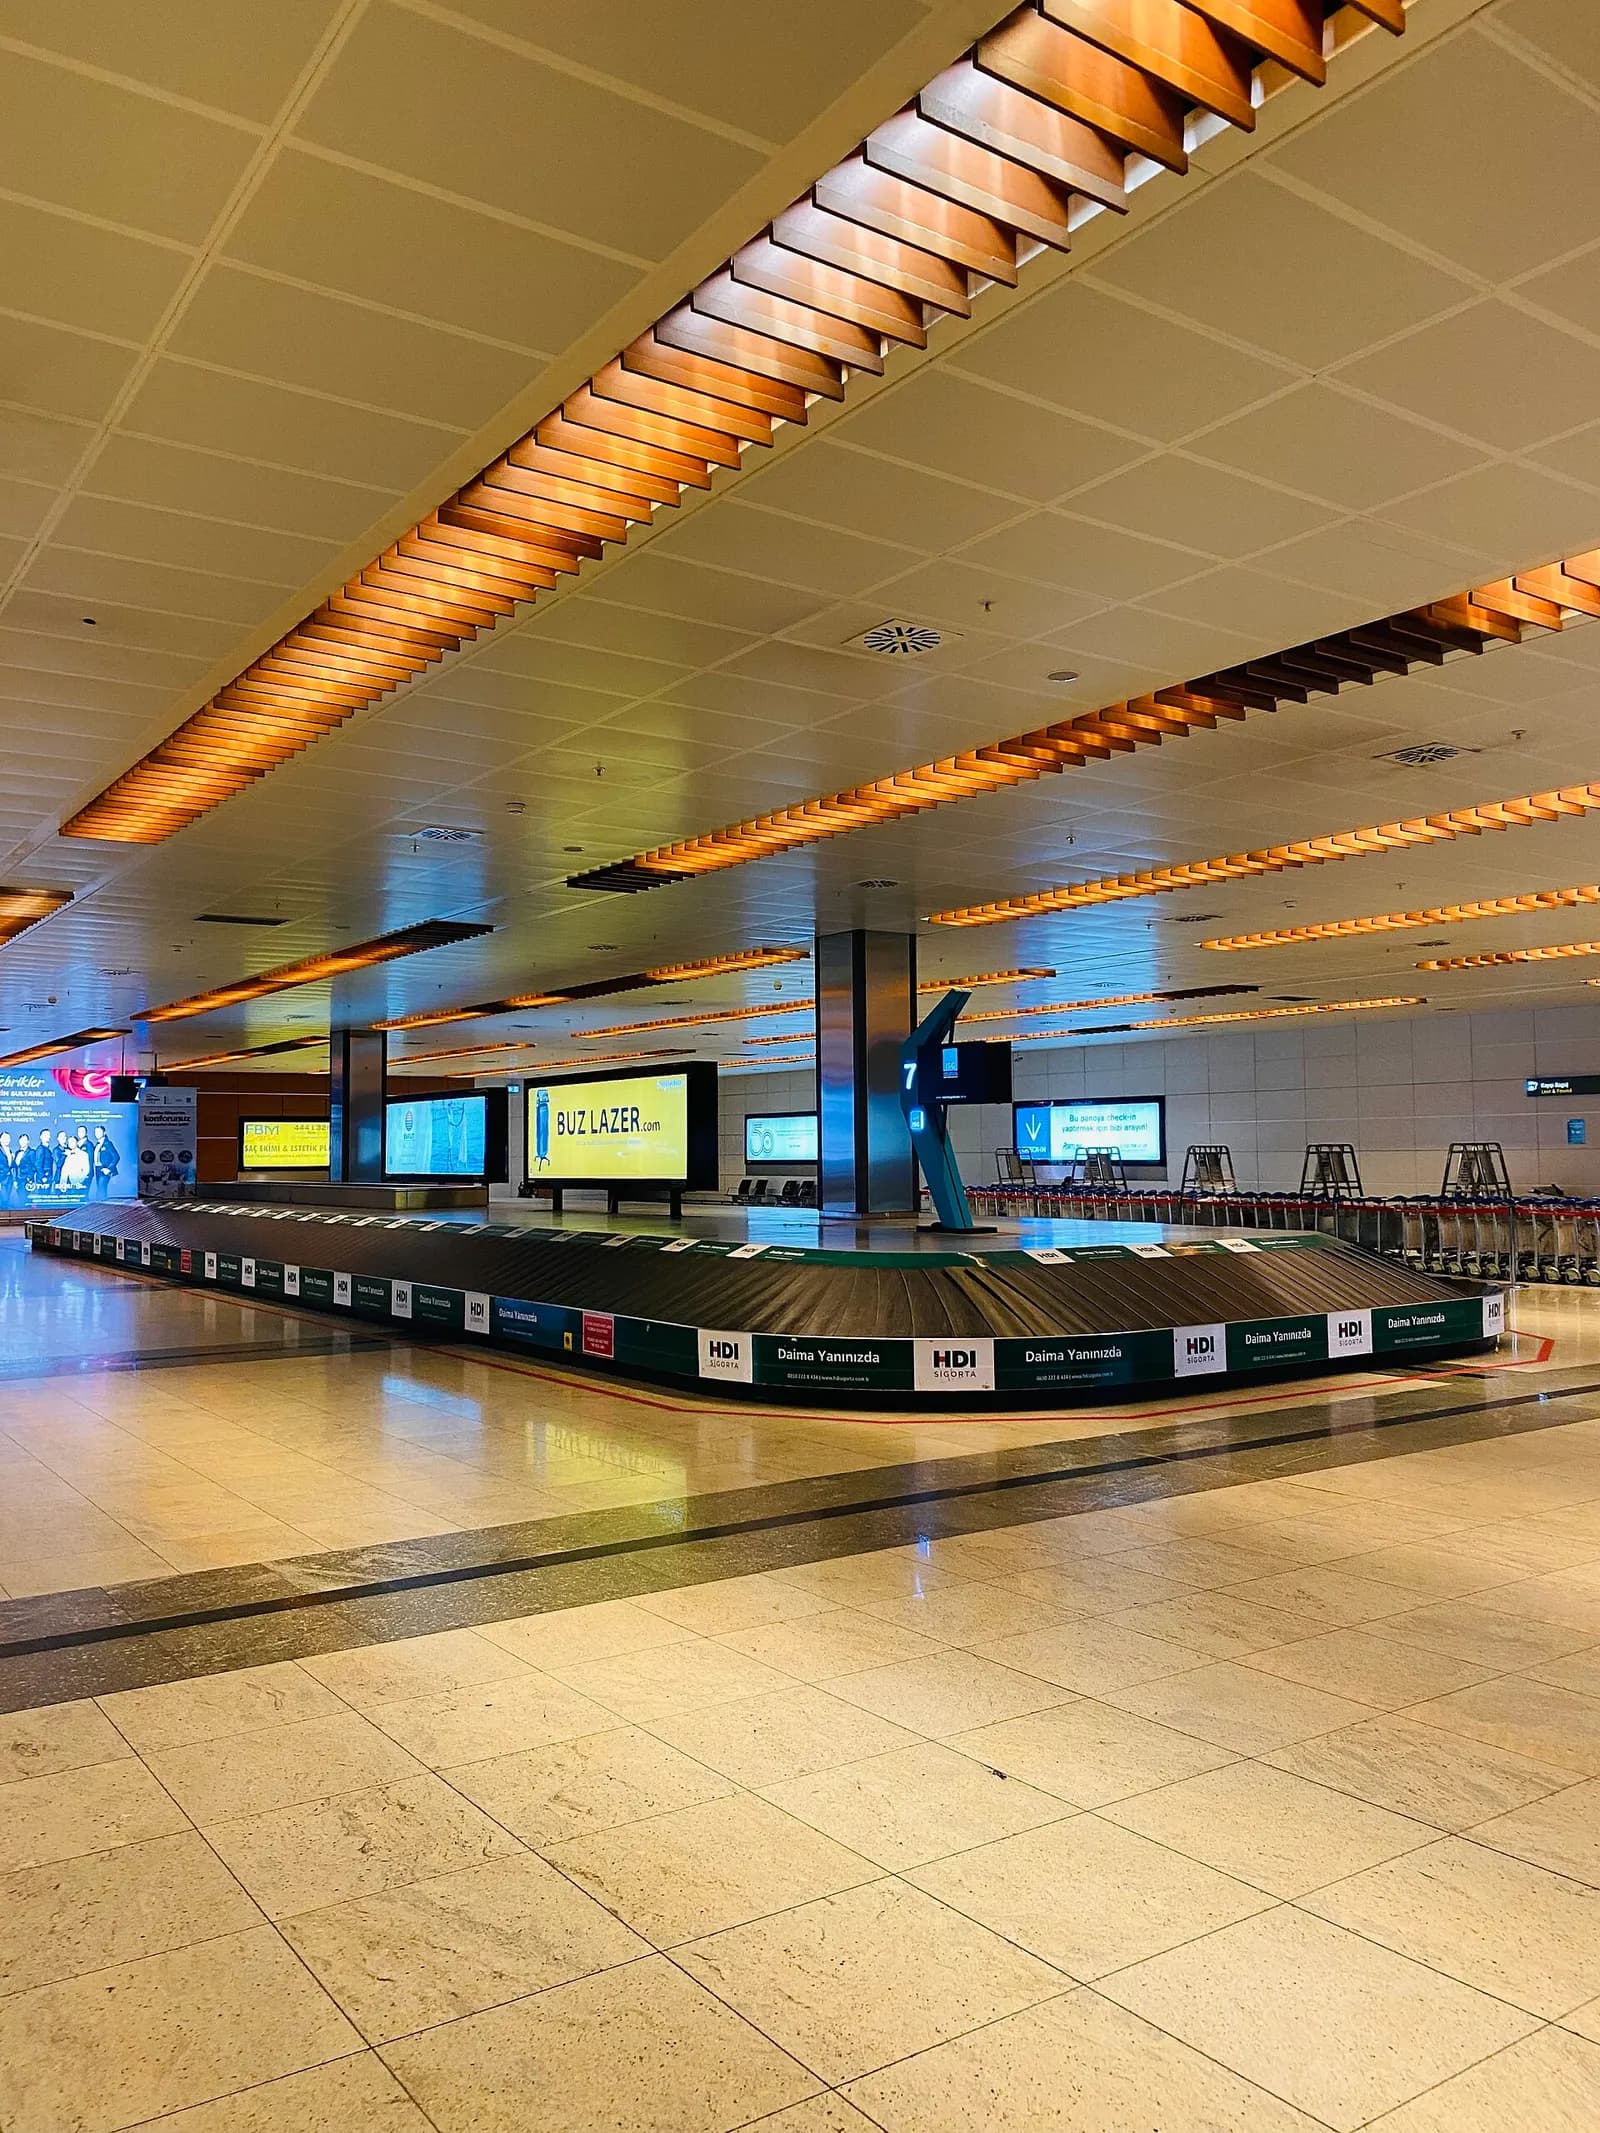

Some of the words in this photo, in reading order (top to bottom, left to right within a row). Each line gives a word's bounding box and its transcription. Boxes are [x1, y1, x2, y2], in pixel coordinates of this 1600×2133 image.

[903, 1063, 917, 1090] 7
[557, 1110, 586, 1136] BUZ
[470, 1301, 484, 1318] HDI
[1488, 1303, 1501, 1318] HDI
[1338, 1320, 1363, 1338] HDI
[1388, 1317, 1411, 1329] Daima
[1411, 1312, 1446, 1326] Yanınızda
[1186, 1335, 1215, 1355] HDI
[1245, 1332, 1272, 1345] Daima
[1272, 1327, 1312, 1342] Yanınızda
[709, 1340, 739, 1360] HDI
[777, 1347, 815, 1362] Daima
[817, 1349, 880, 1364] Yanınızda
[933, 1350, 977, 1368] HDI
[1025, 1349, 1064, 1363] Daima
[1066, 1345, 1122, 1361] Yanınızda
[934, 1369, 977, 1378] SİGORTA
